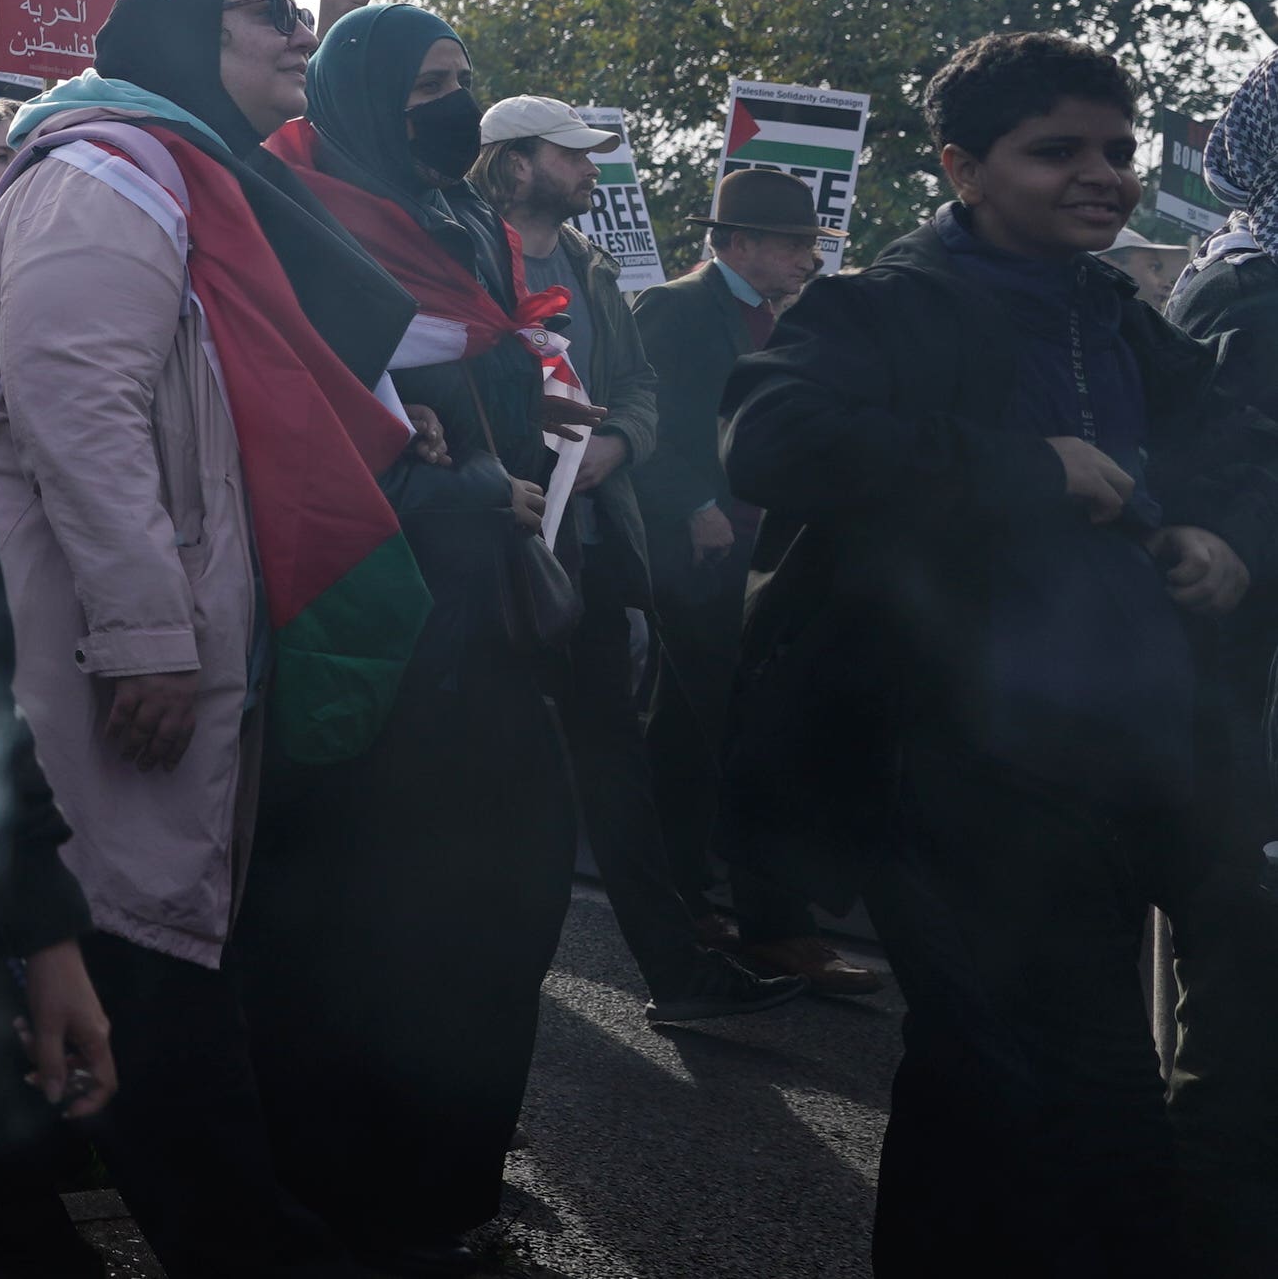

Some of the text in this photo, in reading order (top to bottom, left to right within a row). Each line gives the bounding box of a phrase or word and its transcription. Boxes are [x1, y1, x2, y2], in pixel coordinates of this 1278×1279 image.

[736, 86, 863, 109] Palestine Solidarity Campaign
[1172, 141, 1202, 175] BOM
